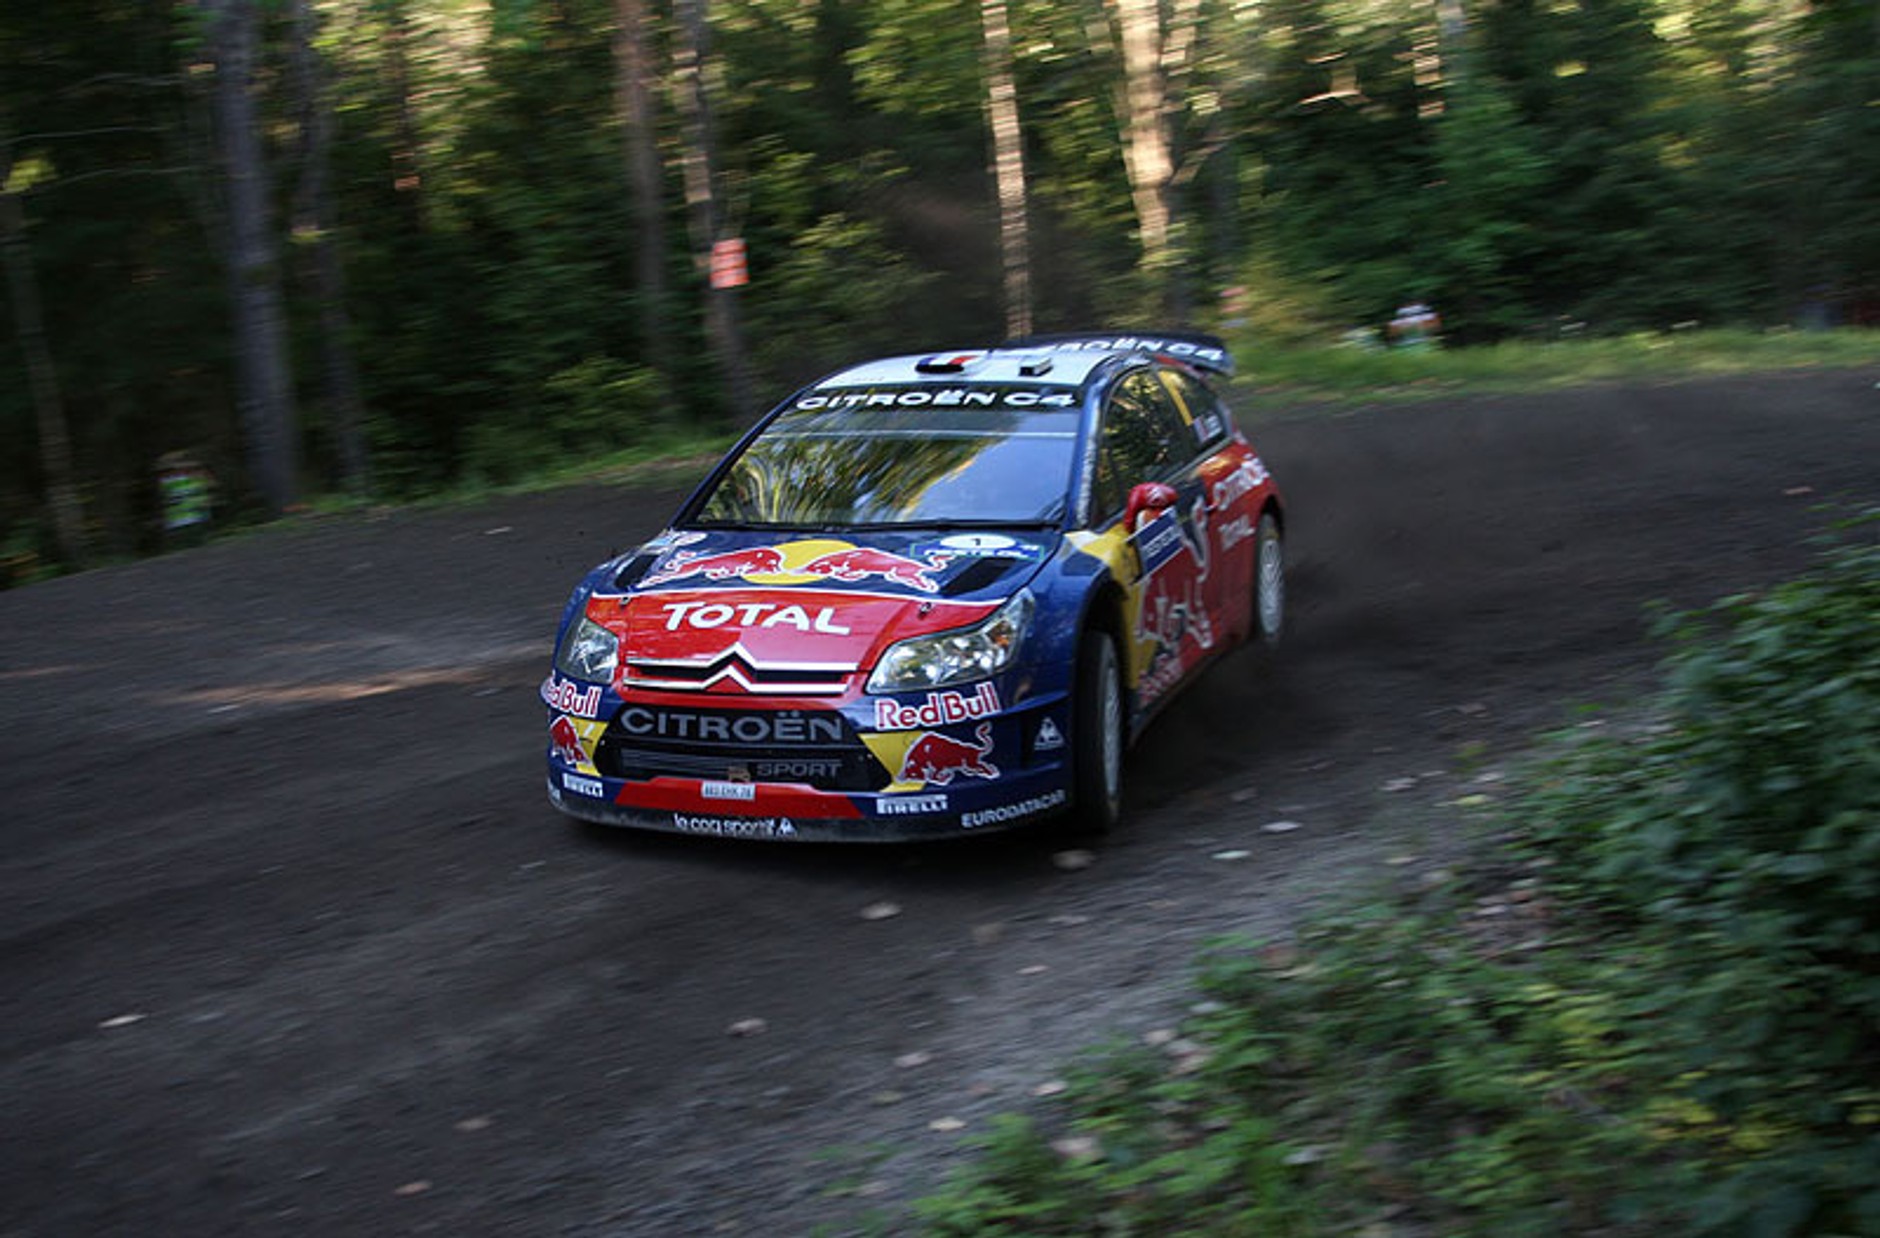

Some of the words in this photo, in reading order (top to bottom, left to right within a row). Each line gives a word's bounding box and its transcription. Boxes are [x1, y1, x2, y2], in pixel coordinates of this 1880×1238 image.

[797, 390, 997, 410] CITROËN
[1004, 392, 1075, 407] C4
[662, 601, 851, 635] TOTAL
[560, 681, 602, 718] Bull
[876, 693, 943, 730] Red
[941, 682, 1000, 724] Bull
[621, 708, 843, 742] CITROËN
[756, 763, 843, 778] SPORT
[876, 794, 949, 815] PIRELLI
[961, 789, 1067, 828] EURODATACAR
[690, 817, 721, 835] coq
